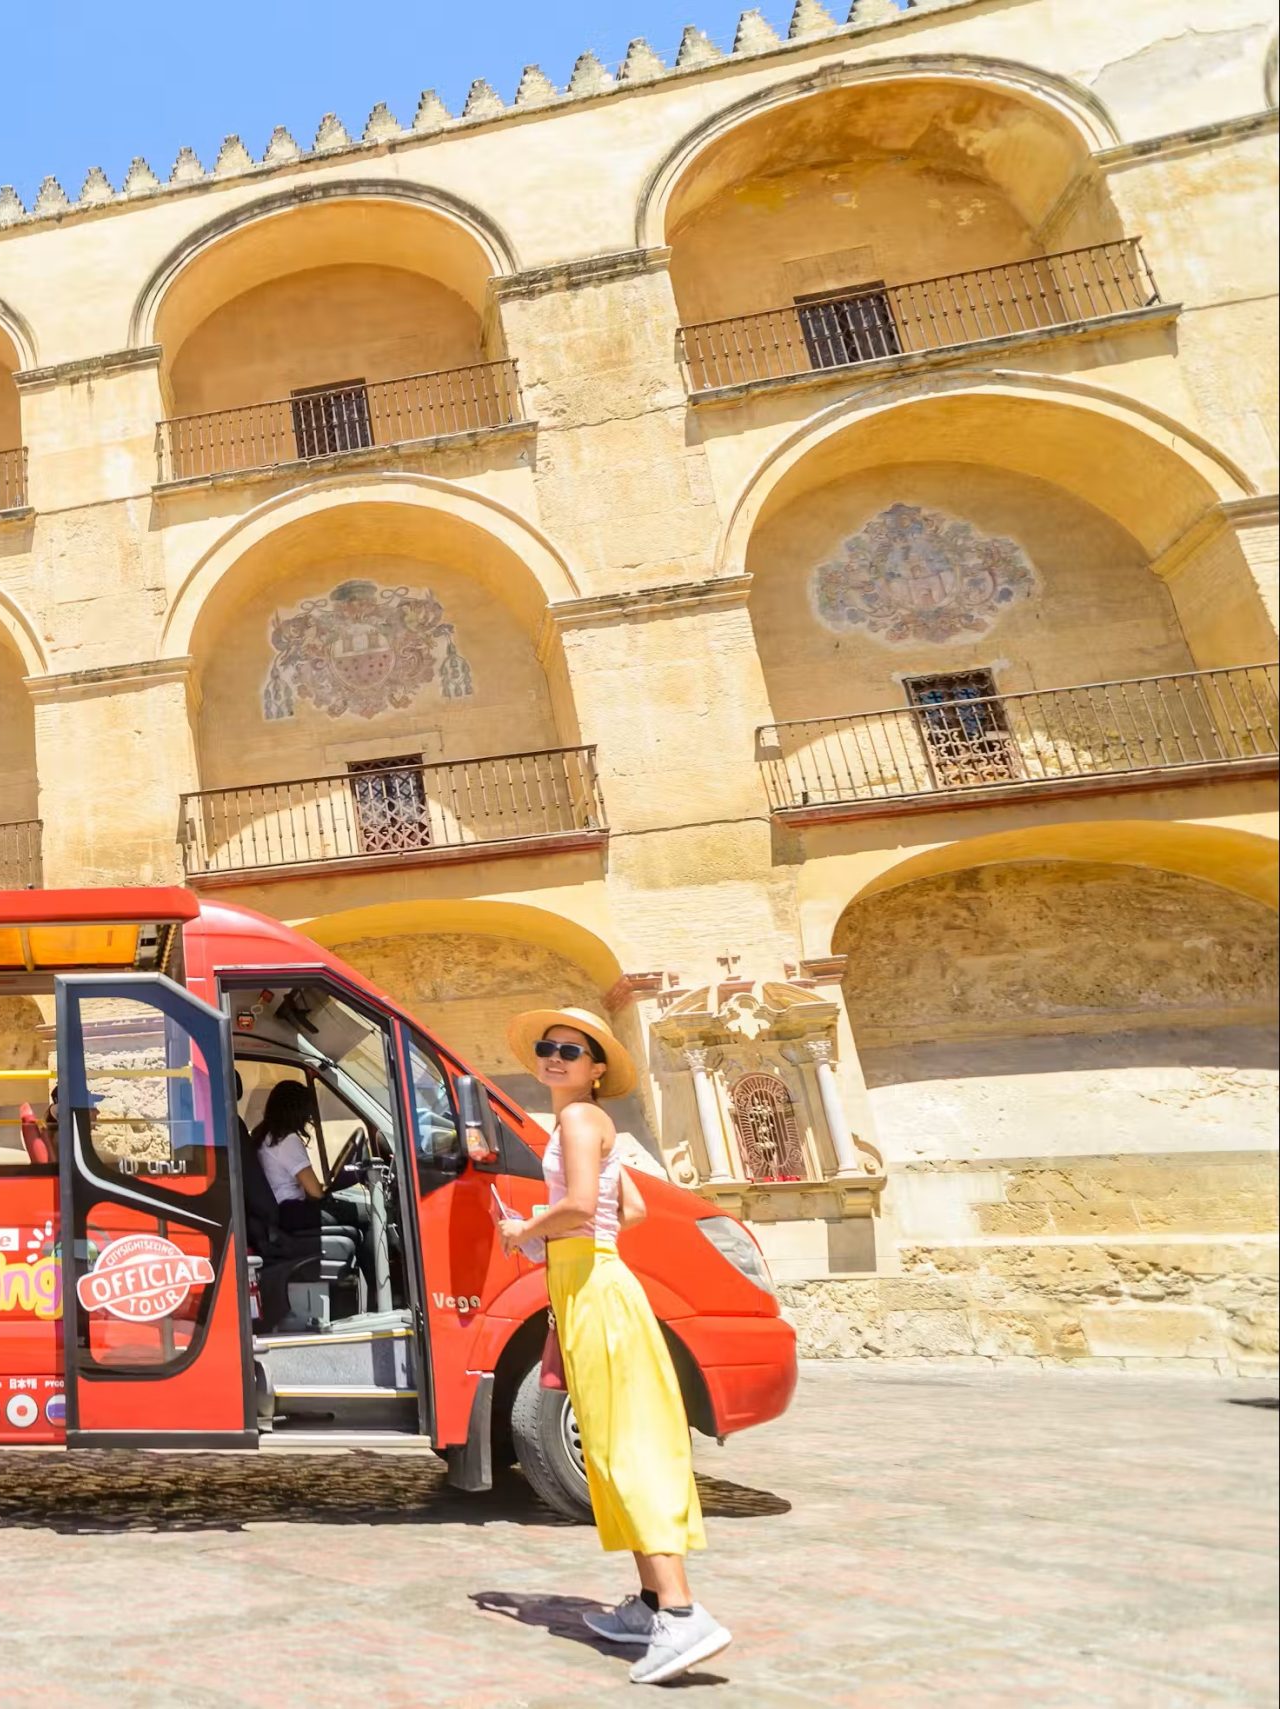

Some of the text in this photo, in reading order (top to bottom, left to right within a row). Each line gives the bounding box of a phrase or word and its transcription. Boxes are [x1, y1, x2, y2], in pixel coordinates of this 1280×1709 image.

[91, 1260, 207, 1301] OFFICIAL
[129, 1289, 181, 1315] TOUR
[431, 1292, 482, 1313] Vega
